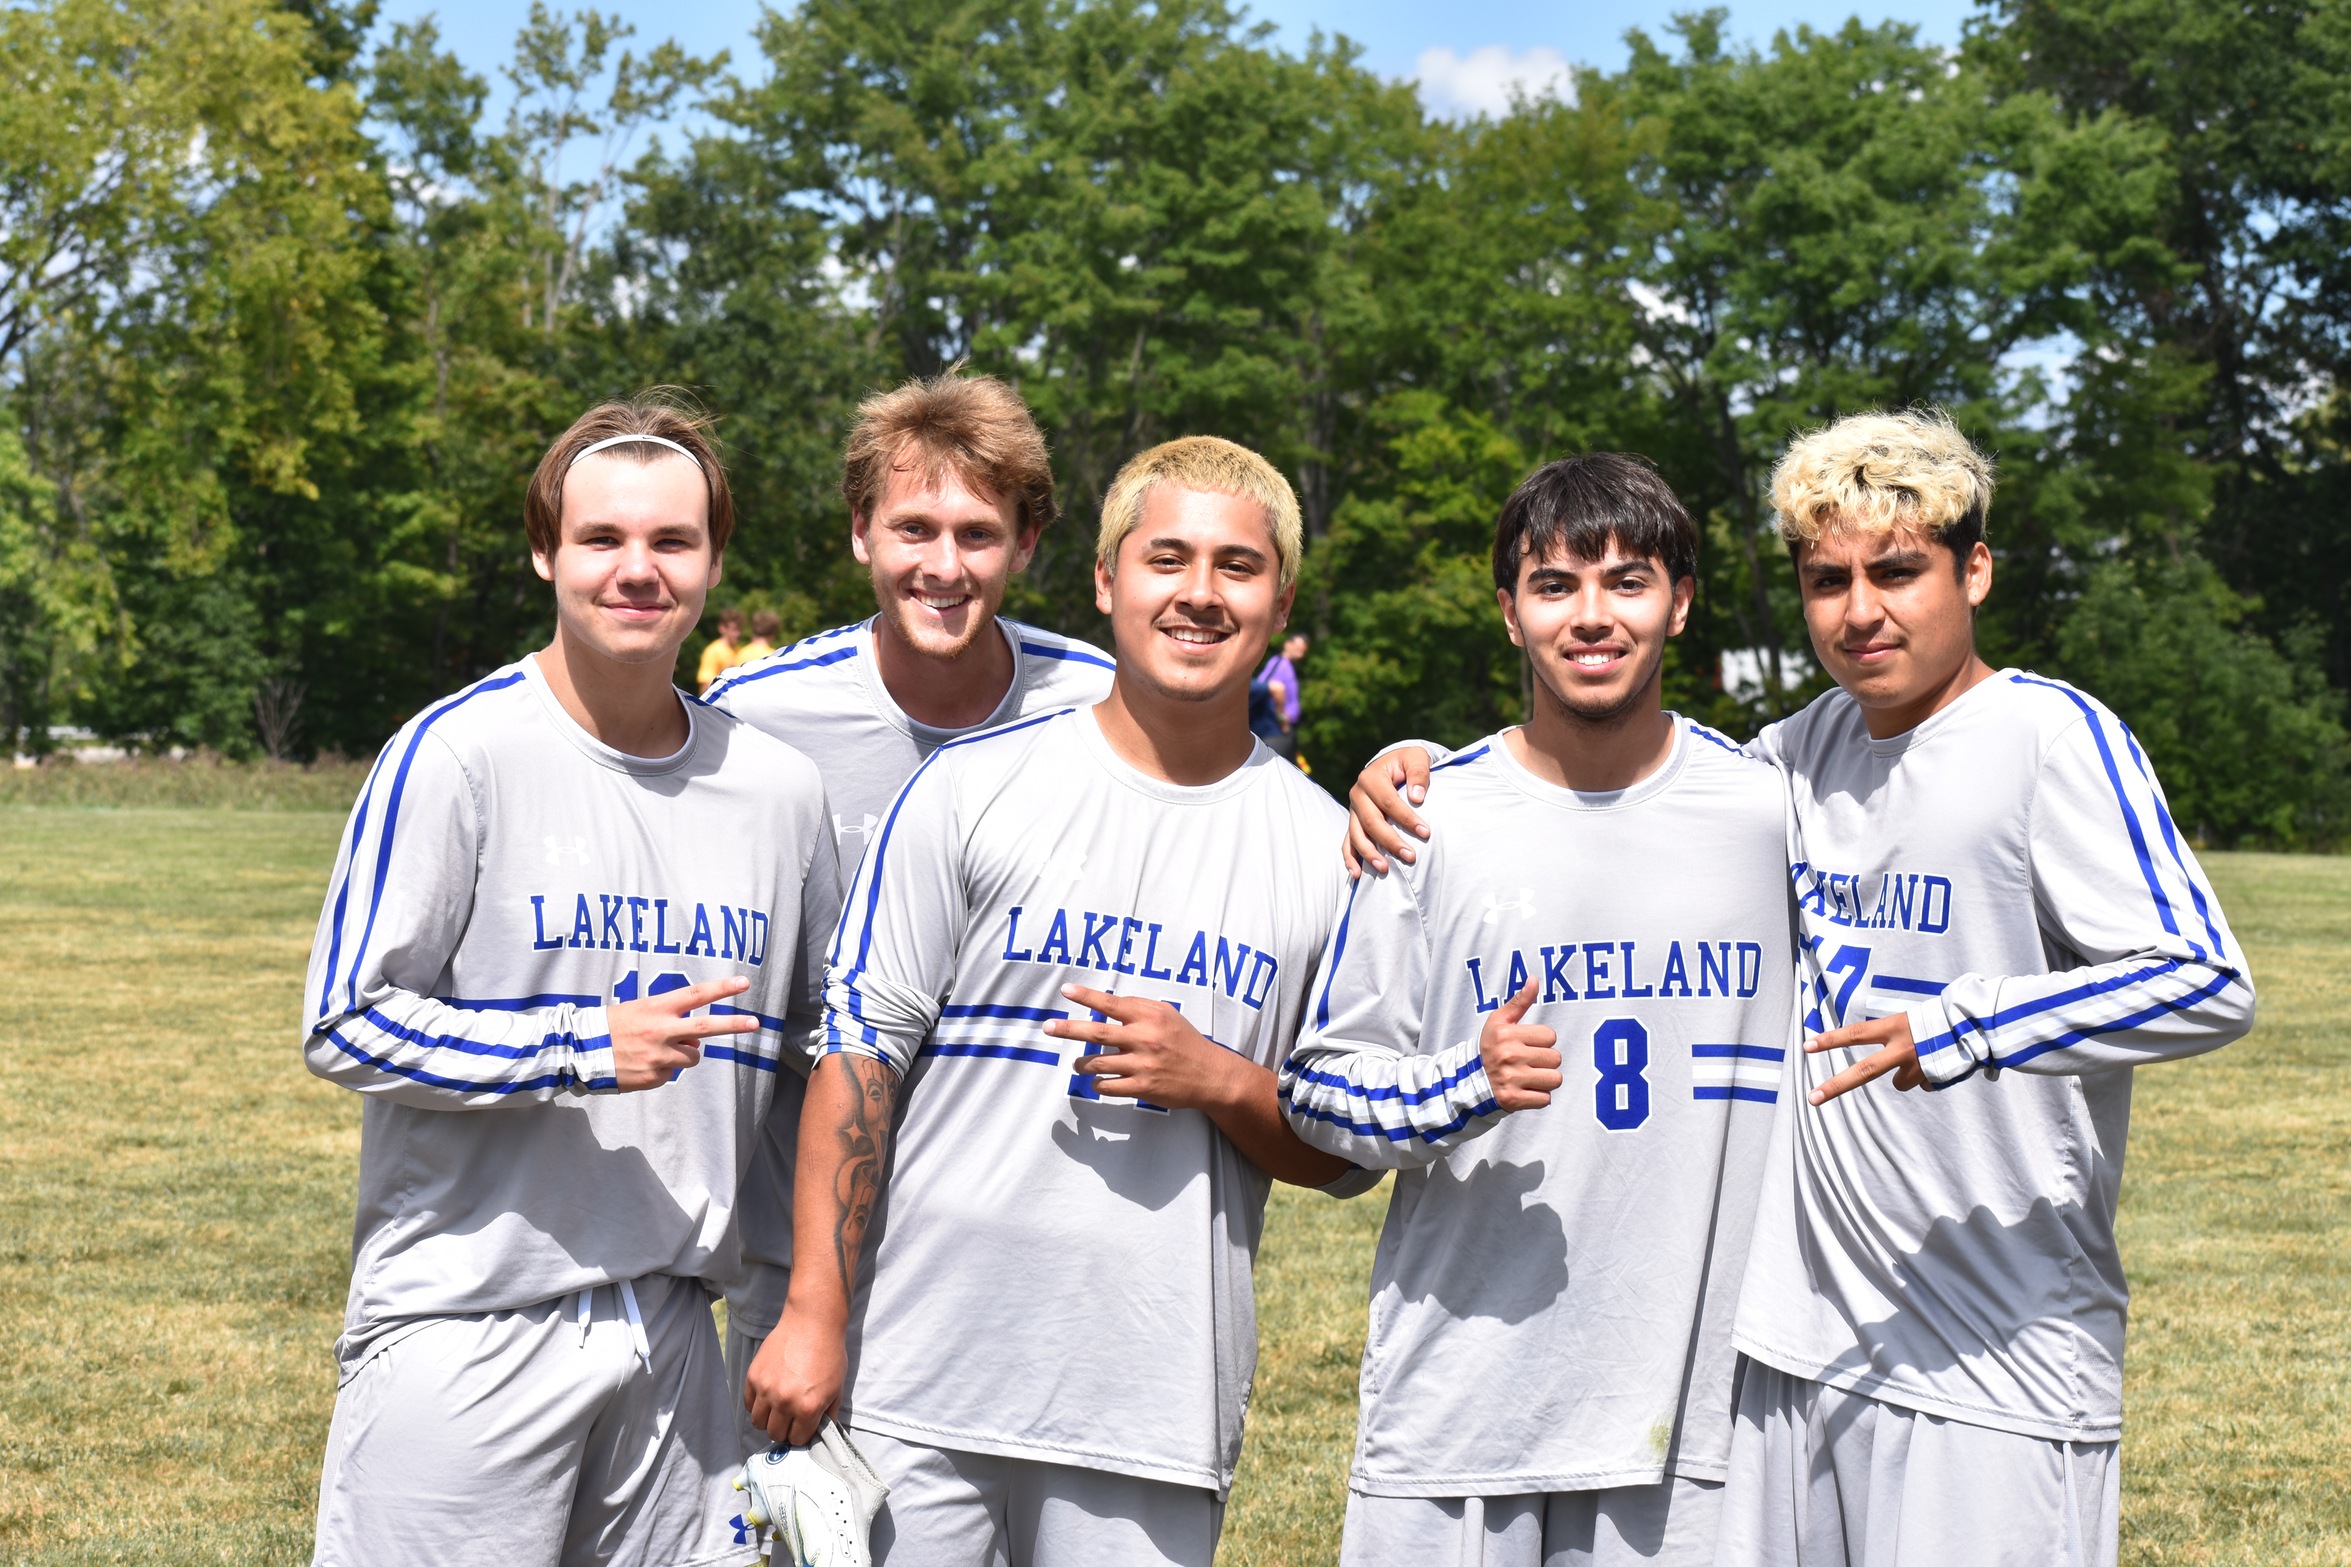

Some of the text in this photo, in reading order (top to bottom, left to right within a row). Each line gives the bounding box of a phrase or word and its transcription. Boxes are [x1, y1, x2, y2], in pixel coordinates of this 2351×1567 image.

[528, 892, 770, 967] LAKELAND
[1790, 862, 1953, 935] KELAND
[1001, 905, 1279, 1011] LAKELAND
[1465, 939, 1763, 1015] LAKELAND
[1591, 1015, 1651, 1133] 8
